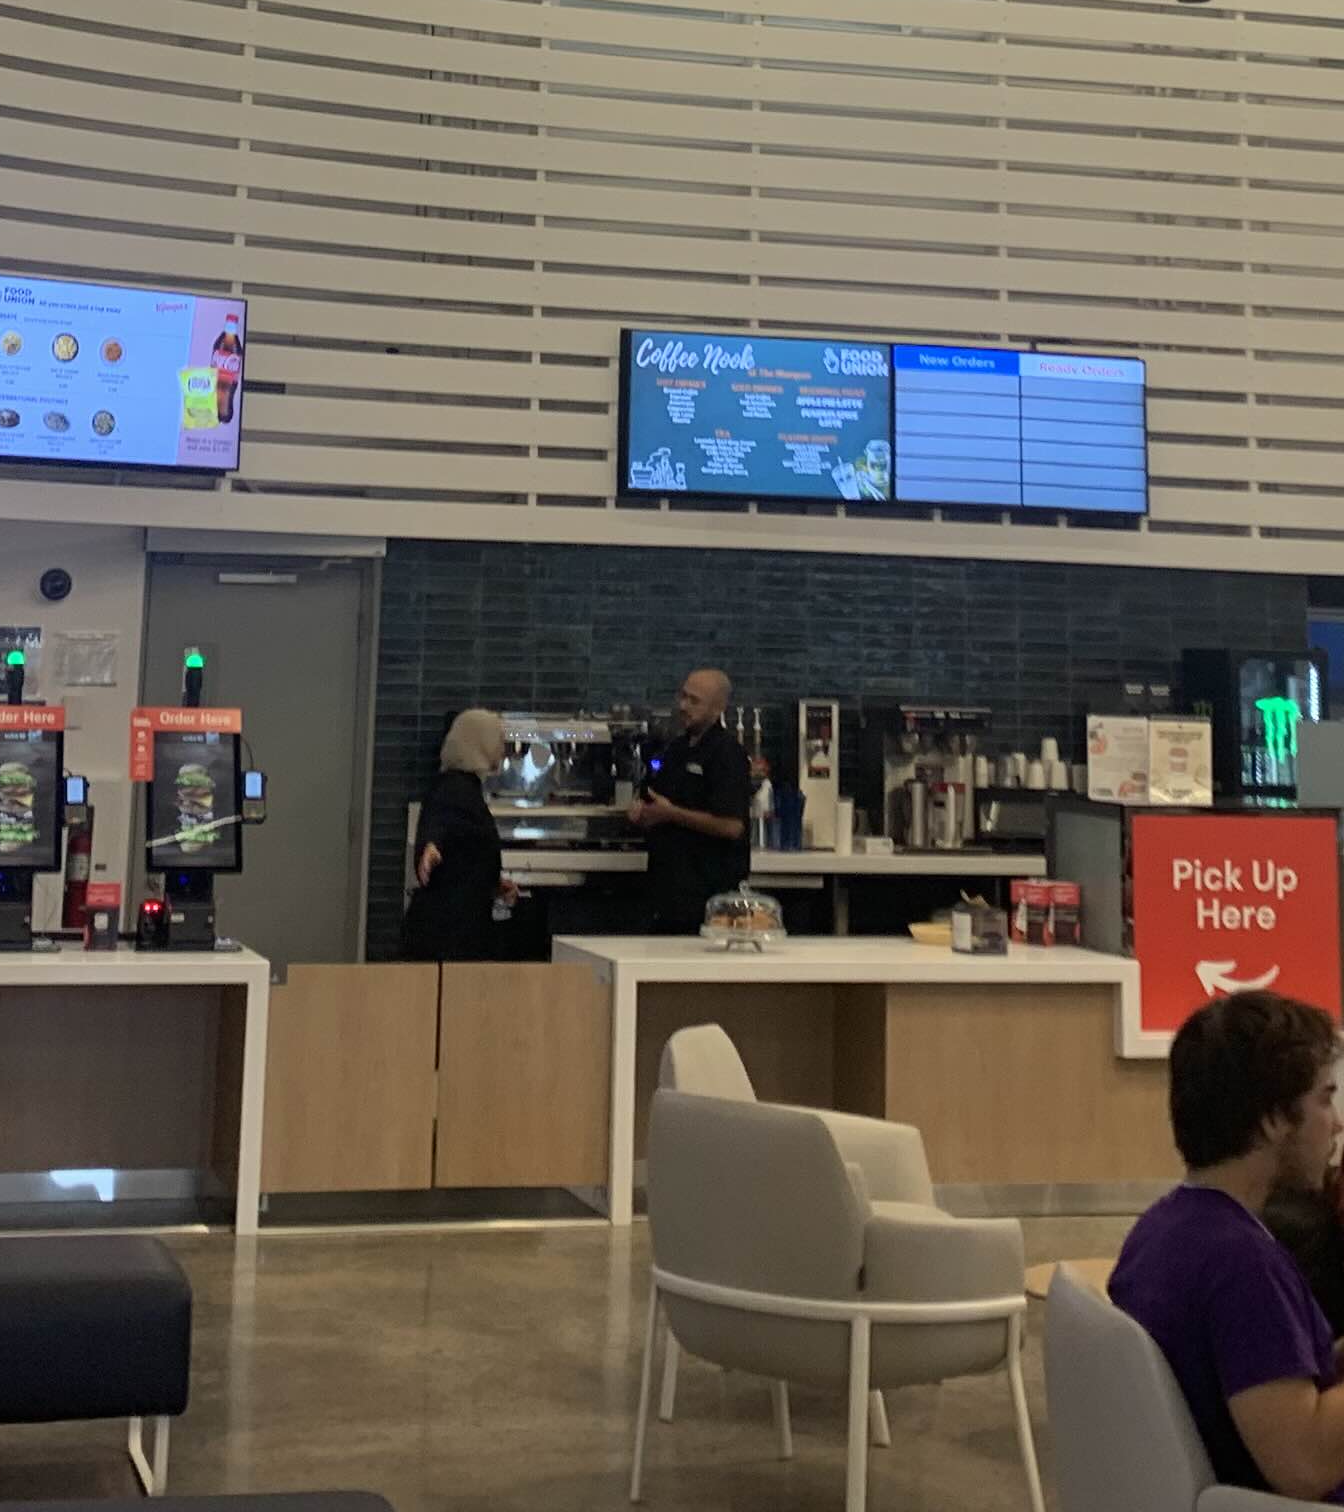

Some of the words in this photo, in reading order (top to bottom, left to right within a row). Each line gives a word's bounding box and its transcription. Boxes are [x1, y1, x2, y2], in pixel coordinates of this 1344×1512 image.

[4, 295, 35, 305] UNION
[5, 288, 32, 297] FOOD
[636, 338, 699, 374] Coffee
[703, 343, 755, 376] Nook
[840, 348, 884, 364] FOOD
[919, 353, 949, 367] New
[951, 354, 996, 369] Orders
[840, 360, 889, 377] UNION
[1039, 362, 1079, 377] Ready
[1081, 365, 1125, 378] Orders
[23, 710, 56, 726] Here
[159, 710, 197, 727] Order
[200, 711, 232, 727] Here
[1172, 858, 1244, 893] Pick
[1251, 860, 1298, 899] Up
[1197, 898, 1276, 930] Here
